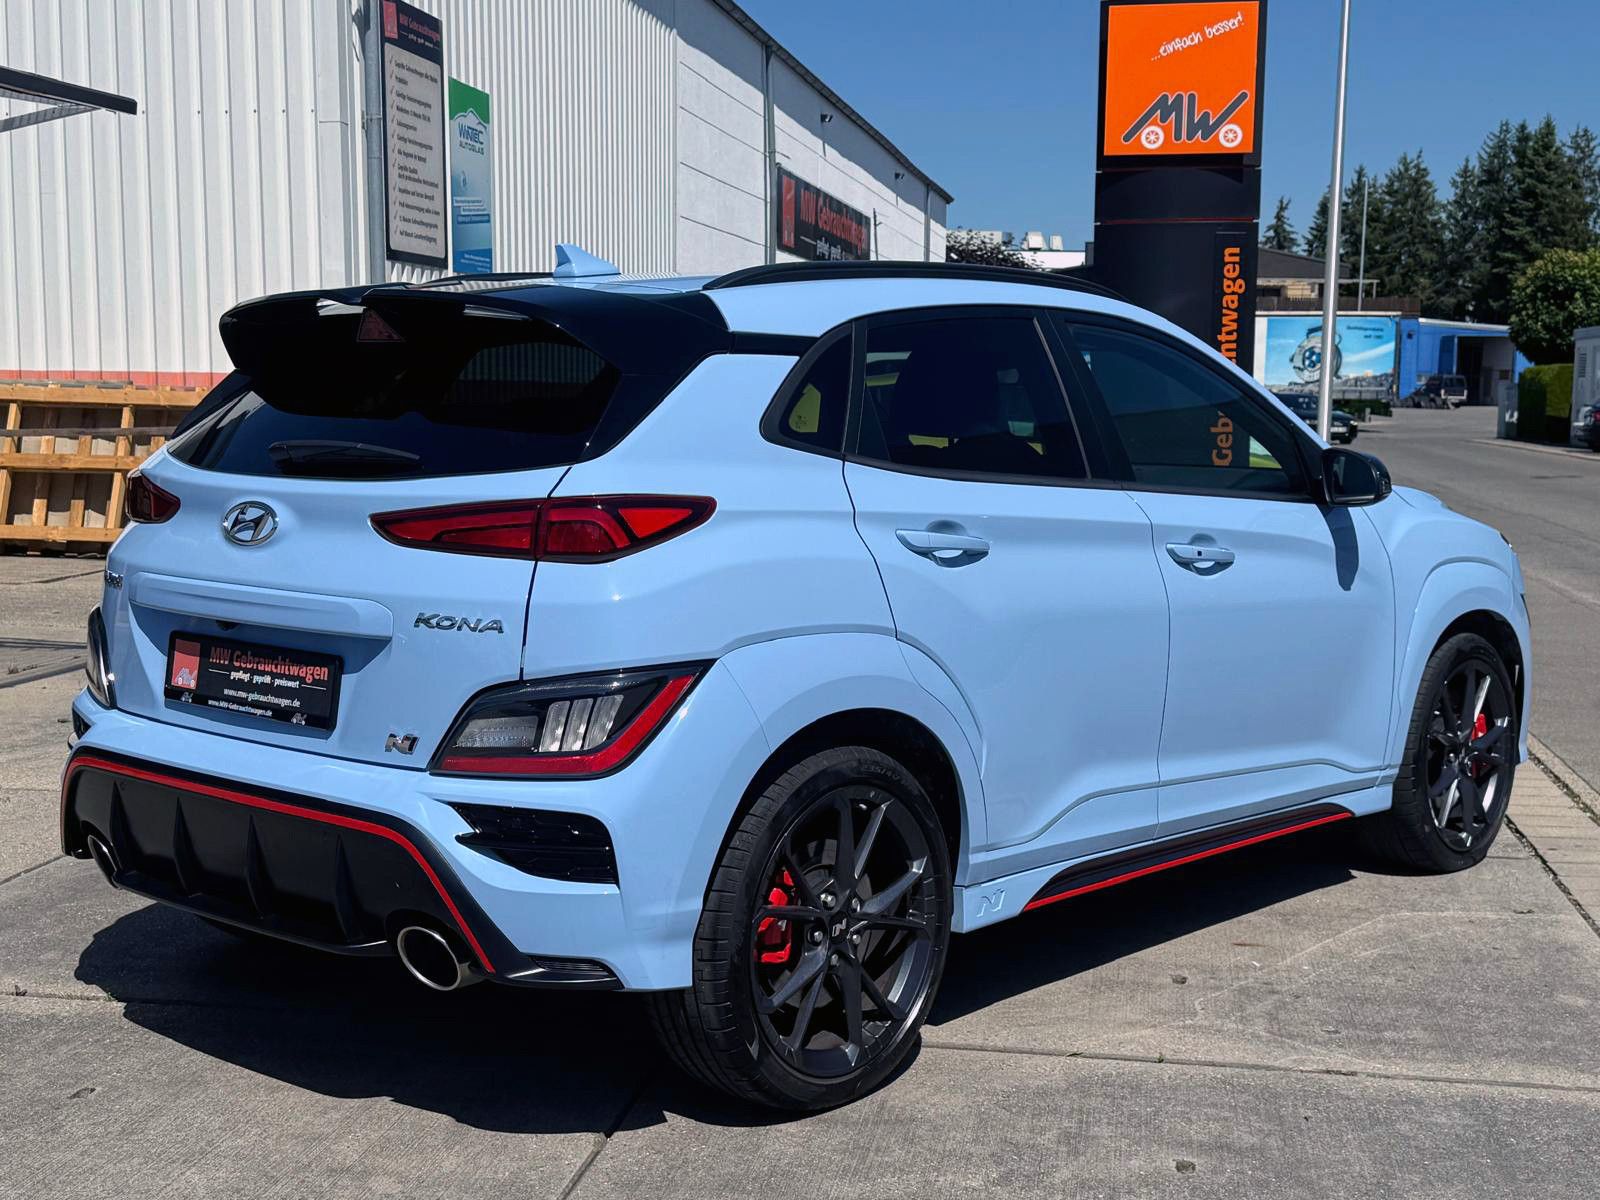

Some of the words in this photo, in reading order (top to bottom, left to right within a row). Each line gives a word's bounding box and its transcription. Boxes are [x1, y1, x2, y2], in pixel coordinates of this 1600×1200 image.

[1204, 11, 1245, 39] besser!
[1121, 90, 1250, 144] MW
[413, 612, 505, 634] KONA
[209, 646, 230, 665] MW
[233, 651, 328, 684] Gebrauchtwagen
[274, 677, 300, 689] preiswert
